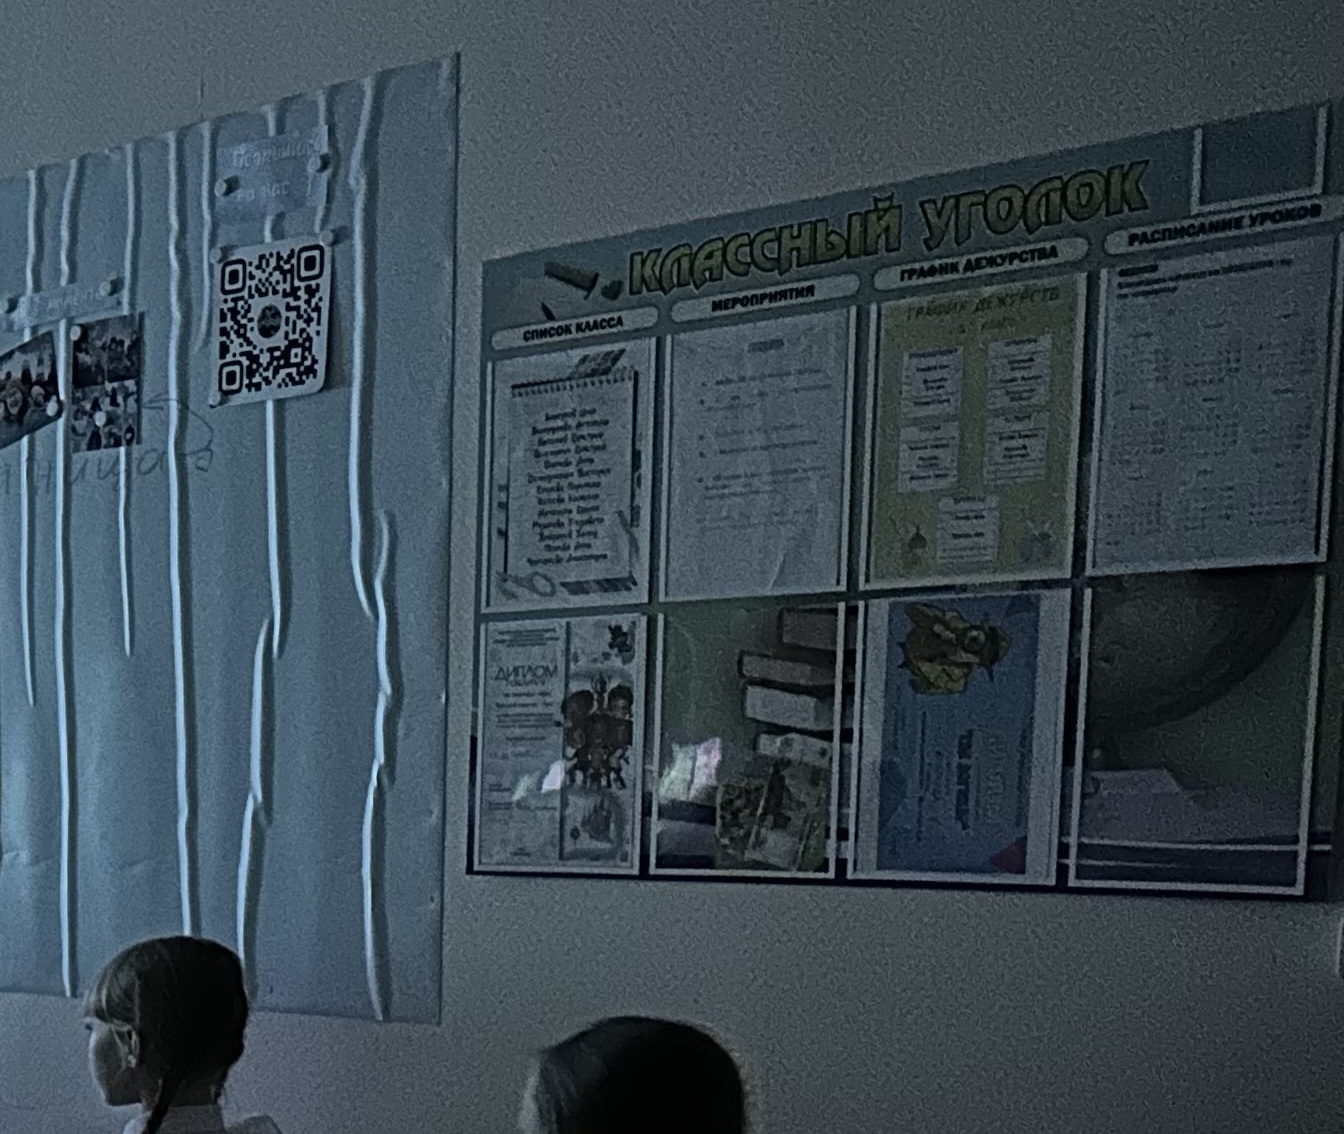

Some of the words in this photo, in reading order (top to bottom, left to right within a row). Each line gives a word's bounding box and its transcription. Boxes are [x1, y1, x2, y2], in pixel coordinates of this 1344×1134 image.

[629, 190, 905, 298] КЛАССНЫЙ
[920, 159, 1152, 252] УГОЛОК
[1127, 216, 1244, 248] РАСПИСАНИЕ
[1248, 202, 1323, 229] УРОКОВ
[899, 260, 960, 283] ГРАФИК
[962, 244, 1060, 274] ДЕЖУРСТВА
[710, 284, 817, 312] МЕРОПРИЯТИЯ
[522, 321, 574, 343] СПИСОК
[575, 315, 625, 335] КЛАССА
[493, 663, 559, 682] ДИПЛОМ
